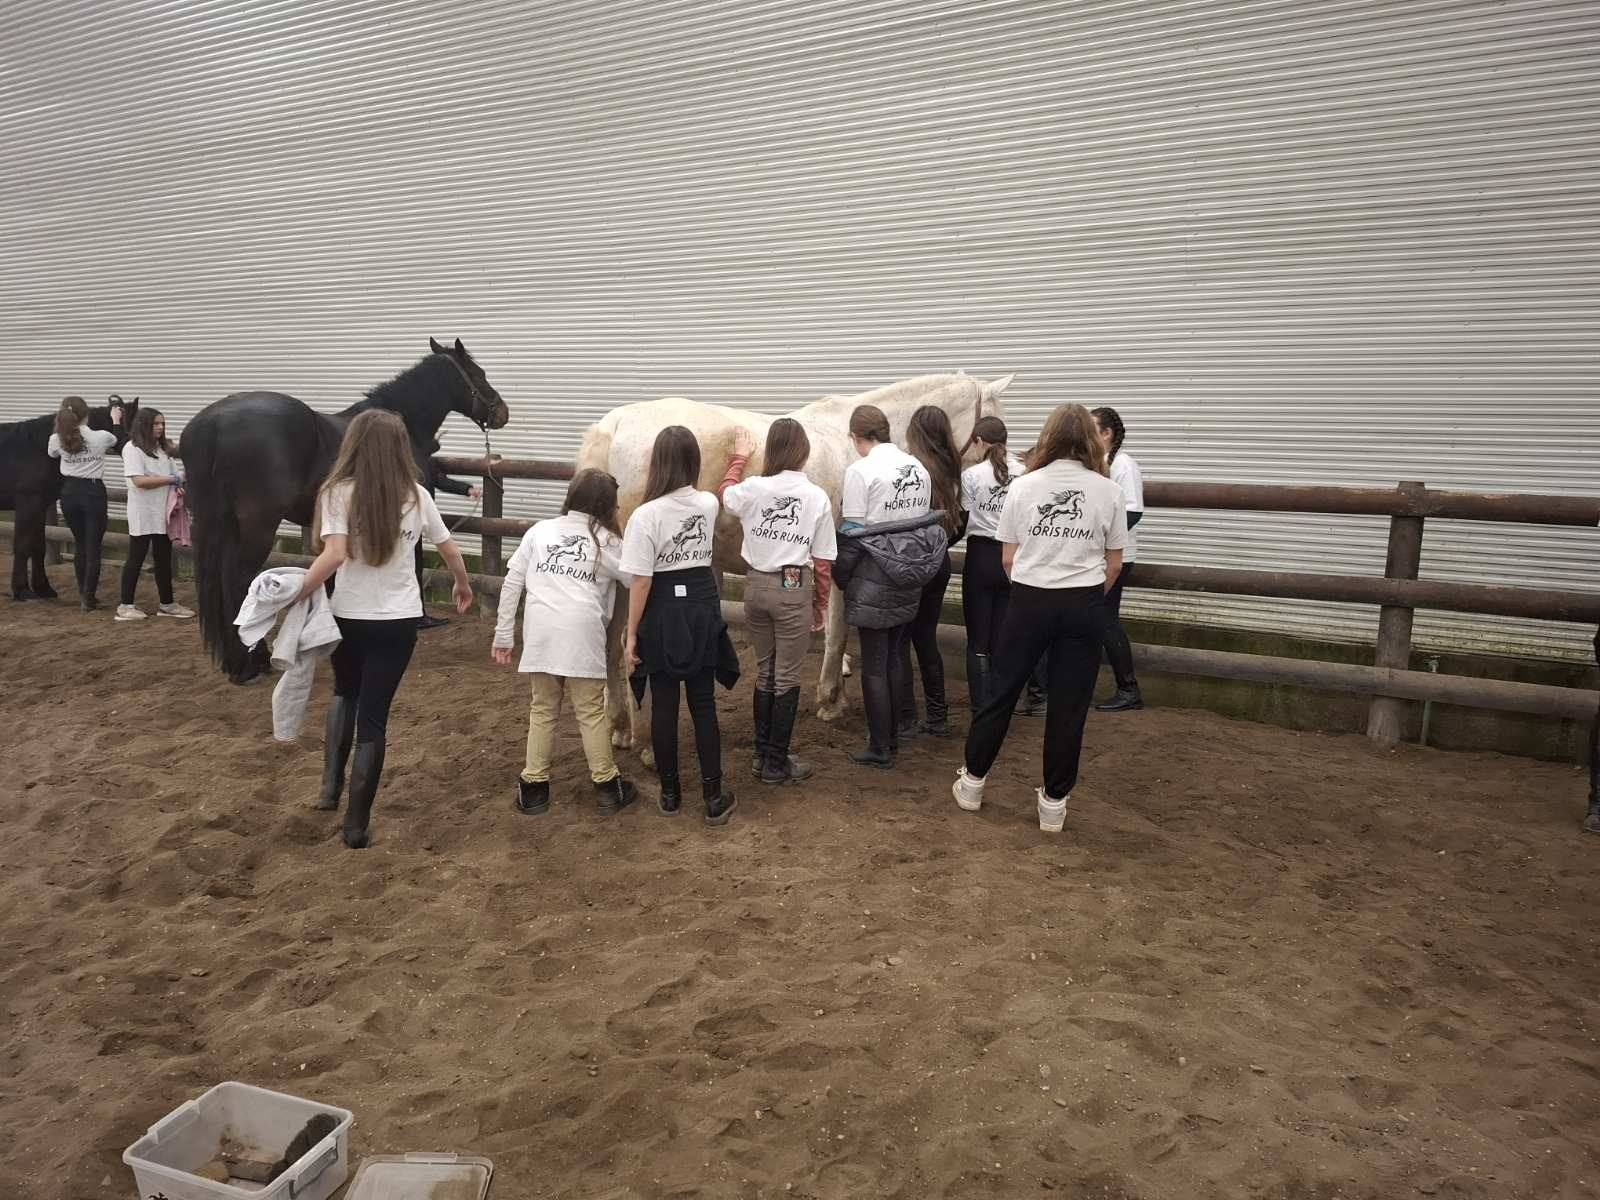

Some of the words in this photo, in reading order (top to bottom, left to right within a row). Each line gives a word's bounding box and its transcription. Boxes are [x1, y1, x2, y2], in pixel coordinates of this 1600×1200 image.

[883, 499, 911, 511] HORIS
[751, 525, 779, 540] HORIS
[780, 531, 810, 546] RUMA
[1028, 525, 1061, 537] HORIS
[1062, 527, 1094, 541] RUMA
[656, 550, 690, 563] HORIS
[692, 549, 713, 560] RUM
[536, 562, 565, 575] HORIS
[566, 566, 597, 583] RUMA
